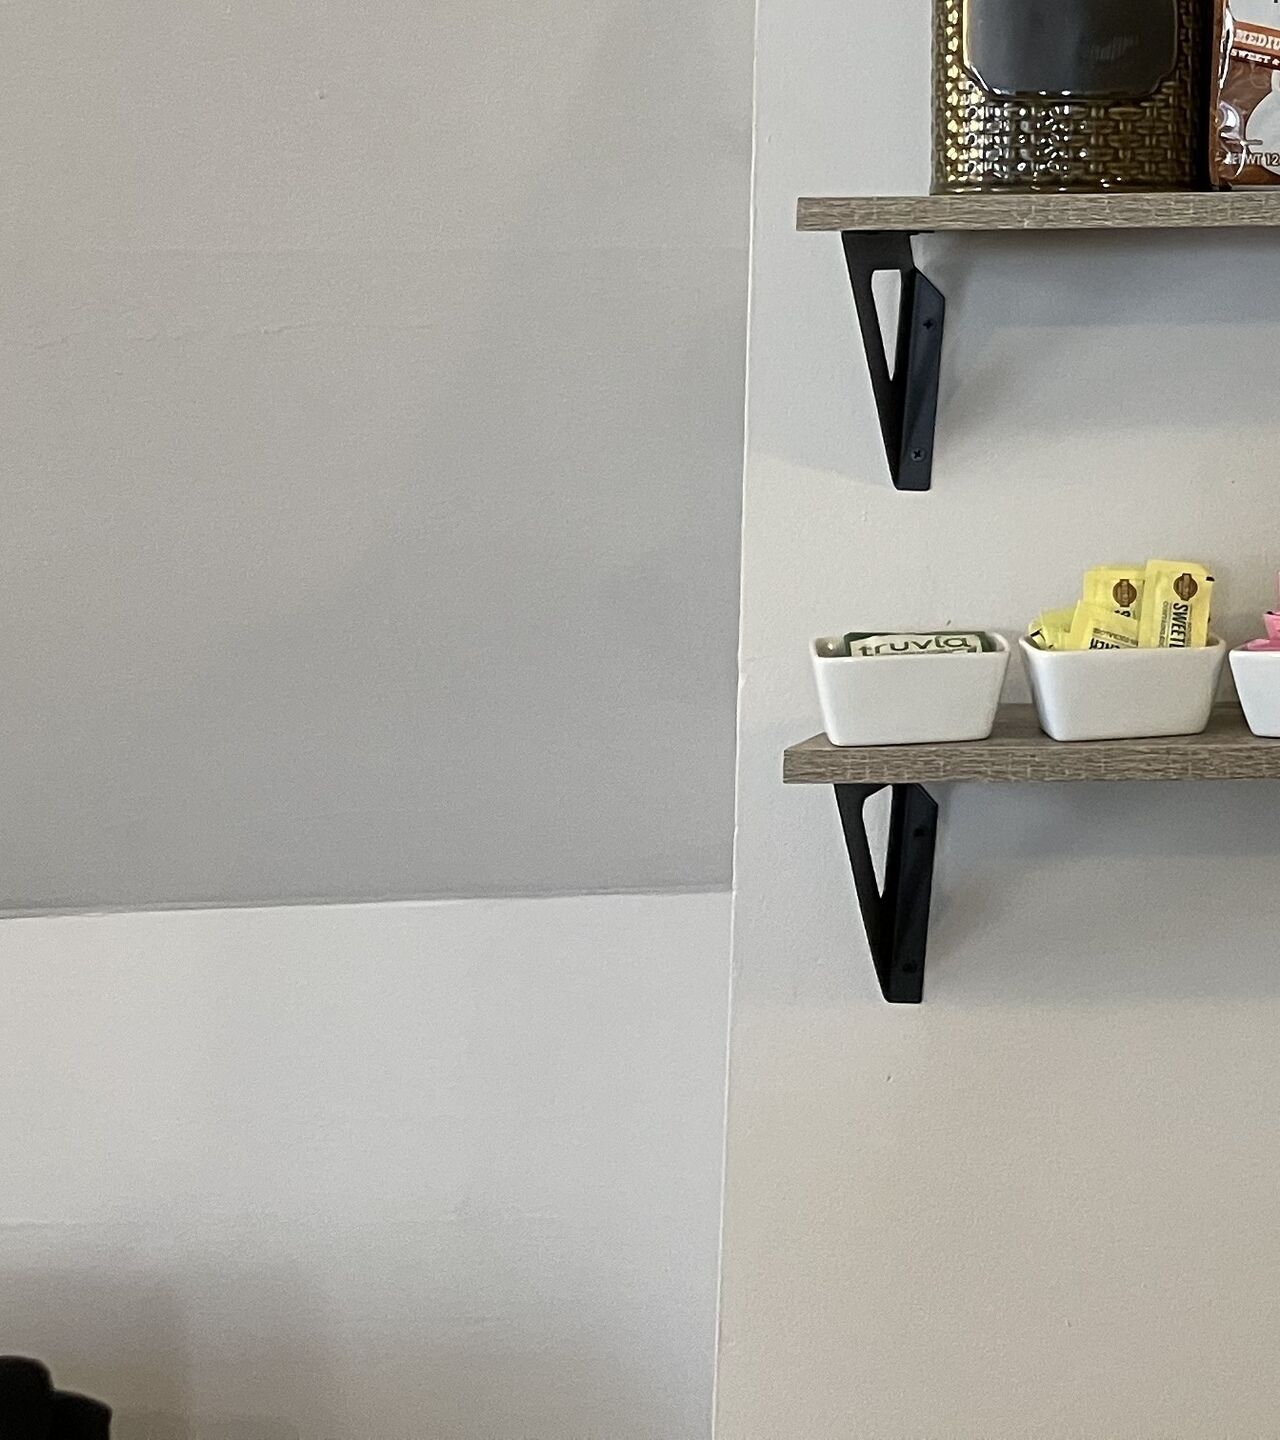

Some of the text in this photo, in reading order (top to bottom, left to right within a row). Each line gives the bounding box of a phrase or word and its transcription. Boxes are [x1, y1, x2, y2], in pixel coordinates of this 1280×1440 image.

[1230, 48, 1271, 65] SWEET
[1271, 58, 1280, 66] &
[1264, 152, 1279, 166] 12
[858, 635, 971, 657] truvia
